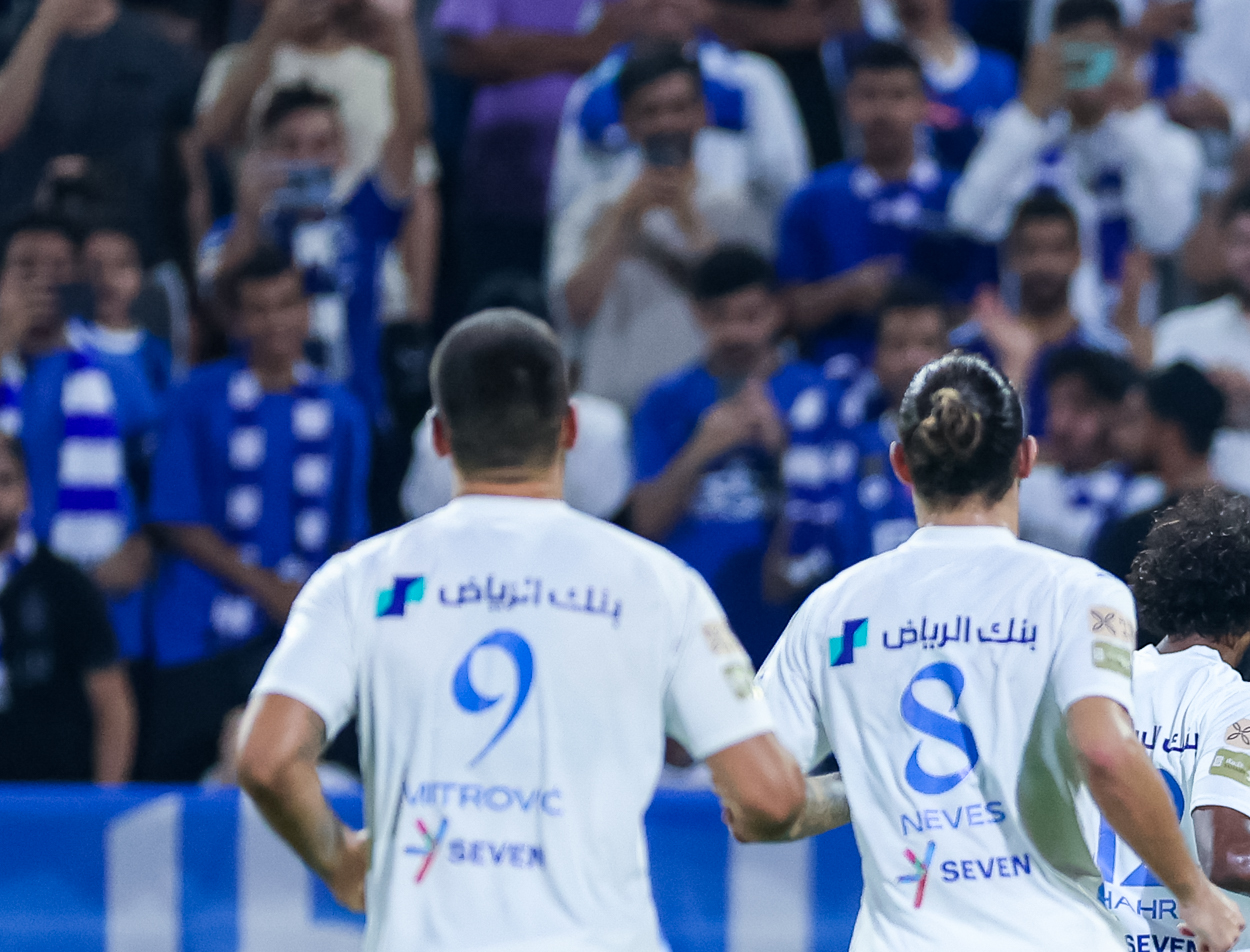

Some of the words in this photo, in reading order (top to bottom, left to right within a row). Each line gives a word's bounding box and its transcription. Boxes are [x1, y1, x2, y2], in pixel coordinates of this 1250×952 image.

[438, 575, 542, 611] الرياض
[549, 583, 622, 628] بنك
[882, 615, 971, 650] الرياض
[977, 616, 1038, 651] بنك
[451, 627, 536, 769] 9
[900, 660, 979, 795] 8
[900, 801, 1006, 836] NEVES
[448, 838, 546, 867] SEVEN
[939, 853, 1032, 883] SEVEN
[1103, 890, 1179, 920] HAHR
